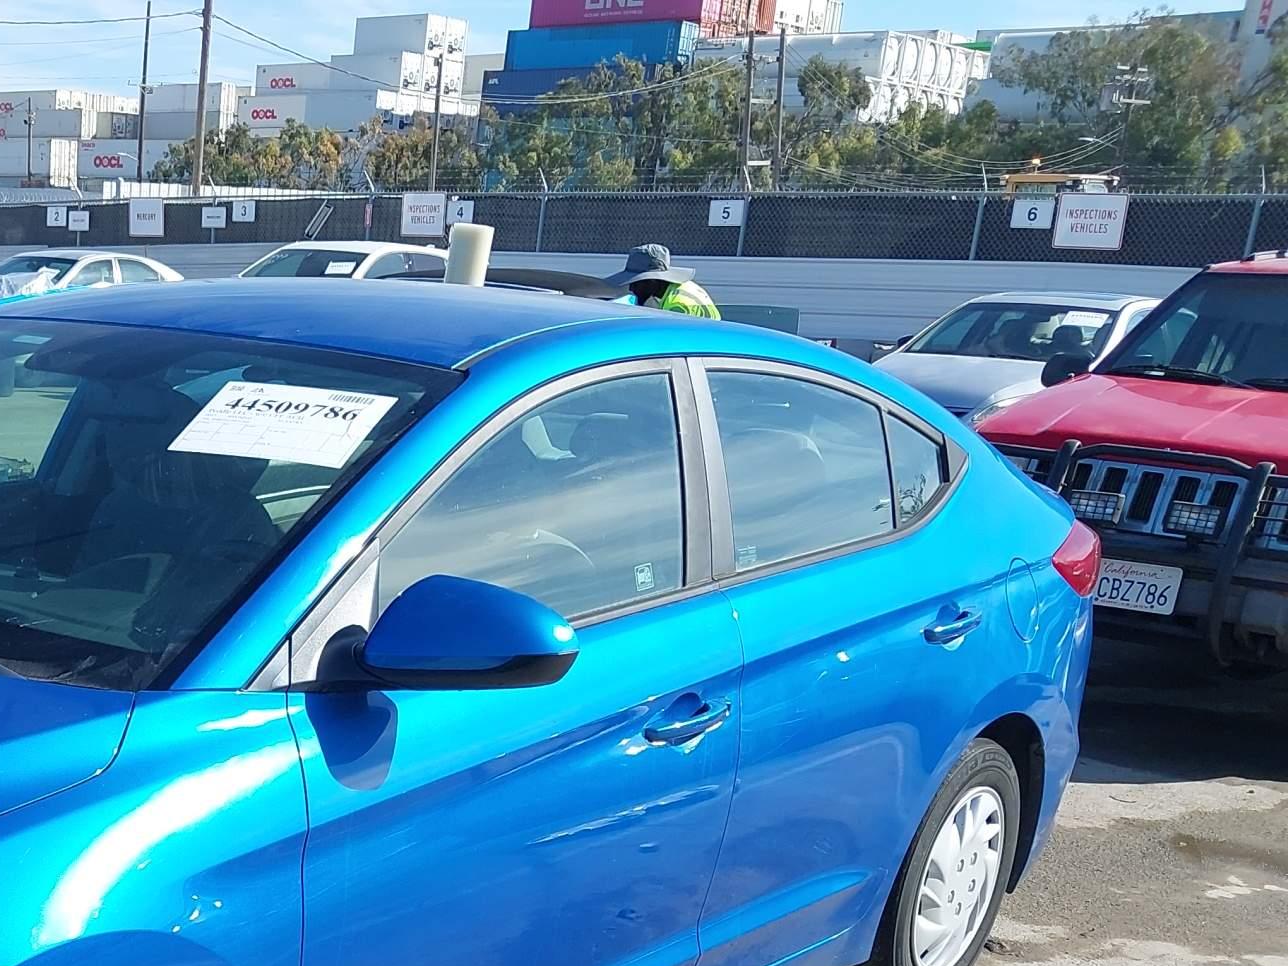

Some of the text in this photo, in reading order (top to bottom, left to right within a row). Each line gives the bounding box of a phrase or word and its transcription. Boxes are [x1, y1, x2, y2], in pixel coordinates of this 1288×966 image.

[241, 205, 247, 217] 3
[407, 204, 441, 214] INSPECTIONS
[456, 206, 464, 218] 4
[721, 206, 731, 220] 5
[1027, 207, 1039, 222] 6
[1065, 208, 1118, 221] INSPECTIONS
[54, 211, 60, 222] 2
[136, 213, 156, 221] MERCURY
[410, 215, 435, 225] VEHICLES
[1070, 222, 1109, 234] VEHICLES
[224, 397, 362, 422] 44509786
[1103, 562, 1161, 580] California
[1097, 576, 1172, 606] CBZ786
